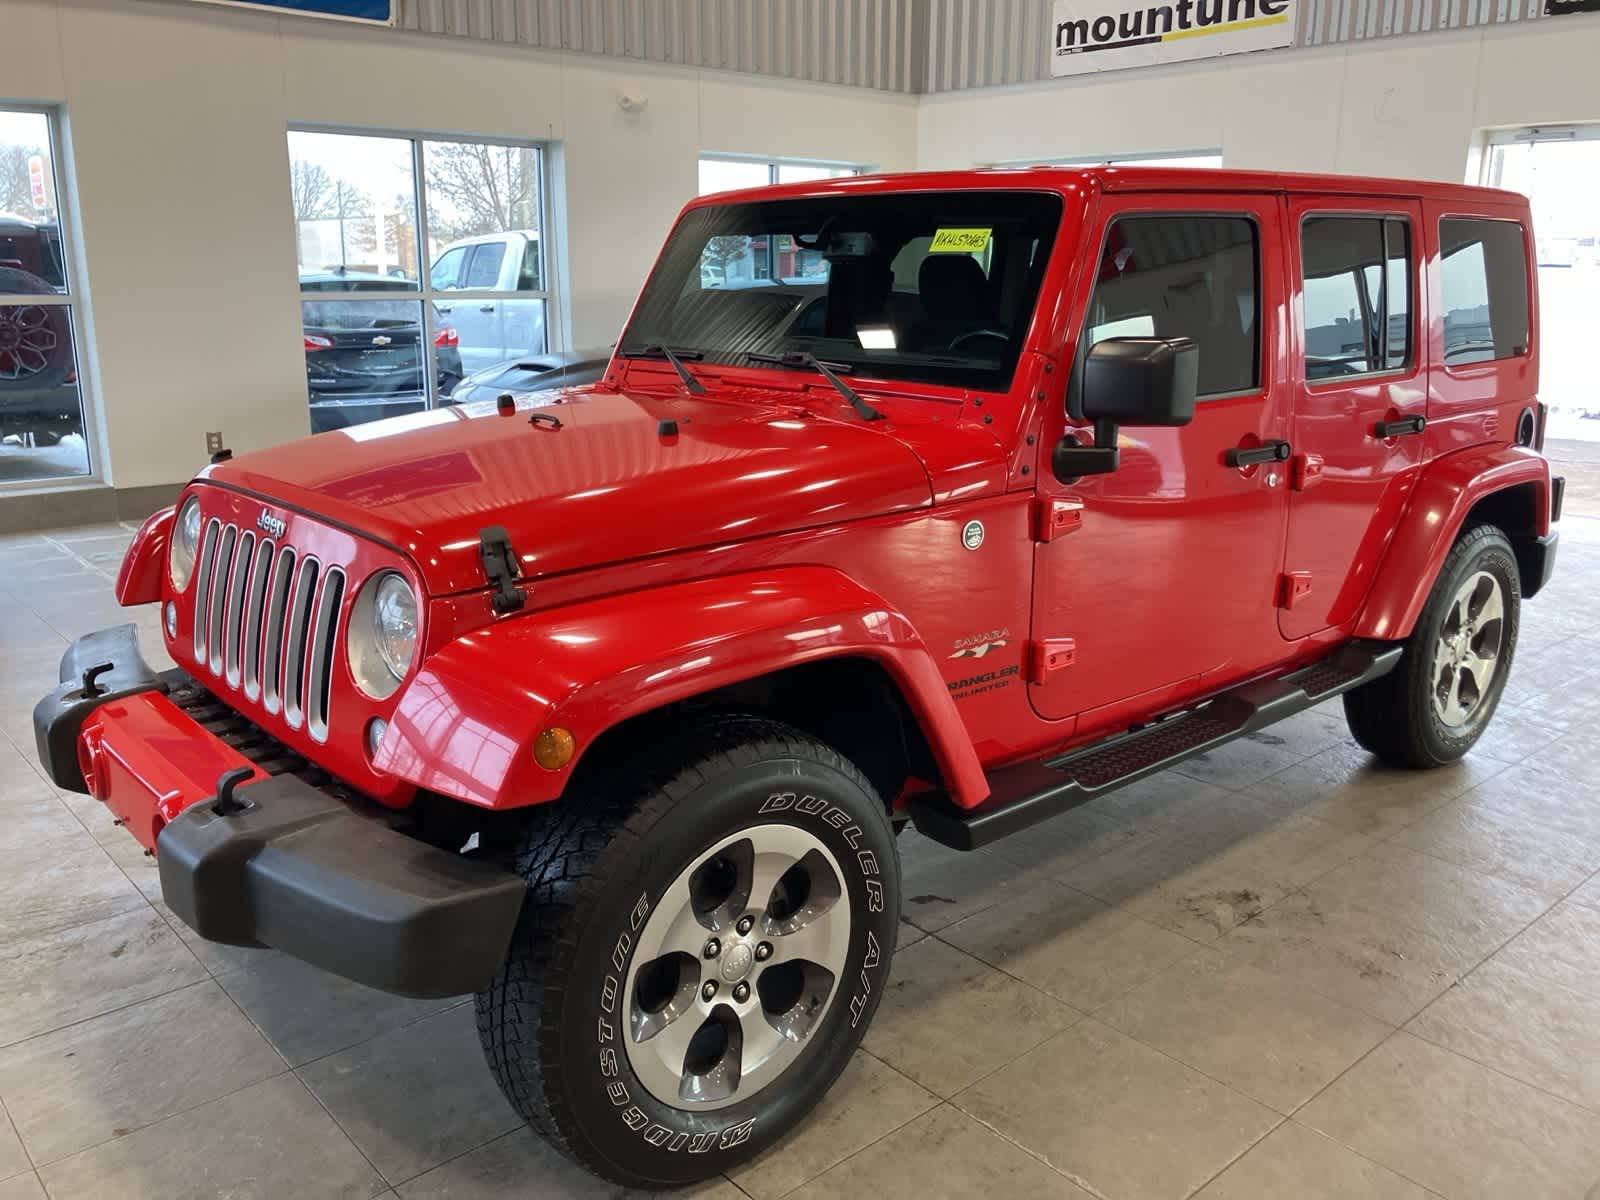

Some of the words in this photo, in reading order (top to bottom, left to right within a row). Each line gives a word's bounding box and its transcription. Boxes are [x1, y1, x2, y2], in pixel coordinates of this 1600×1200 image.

[1056, 0, 1289, 48] mountune
[257, 508, 286, 539] Jeep
[953, 627, 1009, 649] SAHARA
[946, 665, 1019, 690] RANGLER
[758, 791, 884, 914] DUELER
[849, 930, 881, 1029] A/T
[598, 889, 757, 1154] BRIDGESTONE
